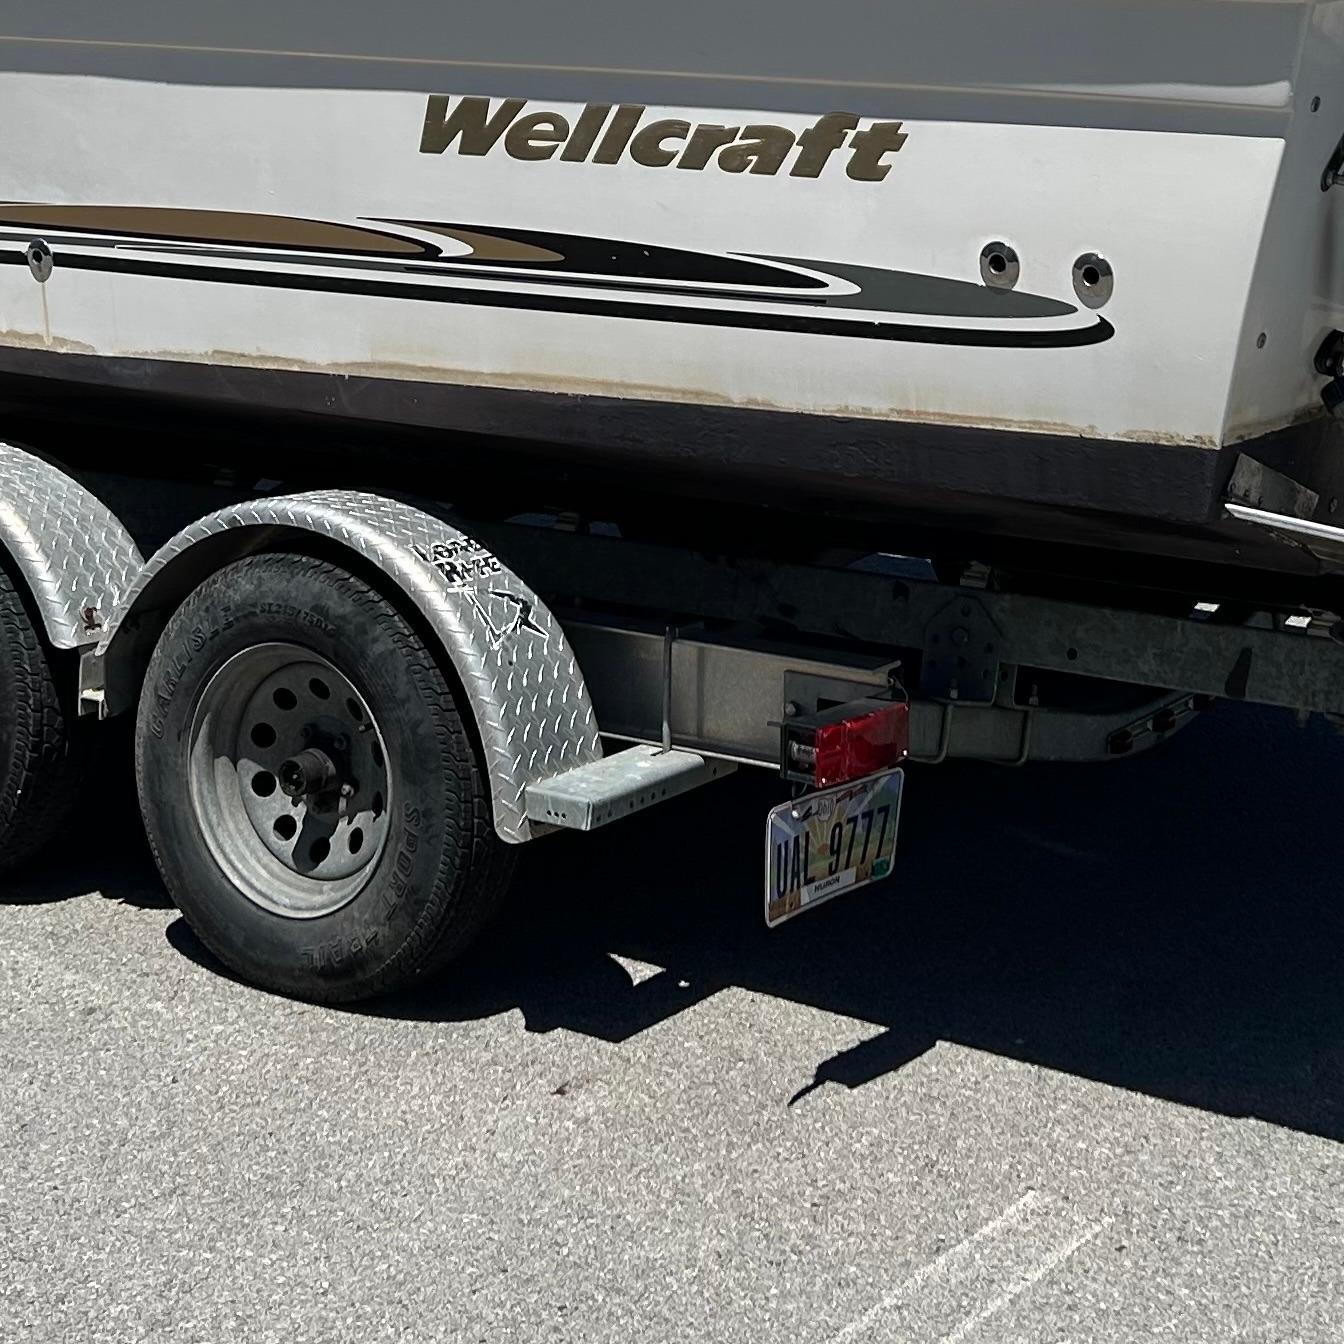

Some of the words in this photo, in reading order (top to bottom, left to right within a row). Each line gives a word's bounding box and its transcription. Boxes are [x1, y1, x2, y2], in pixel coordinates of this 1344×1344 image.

[419, 94, 908, 182] Wellcraft
[776, 831, 816, 899] UAL
[828, 805, 891, 876] 9777
